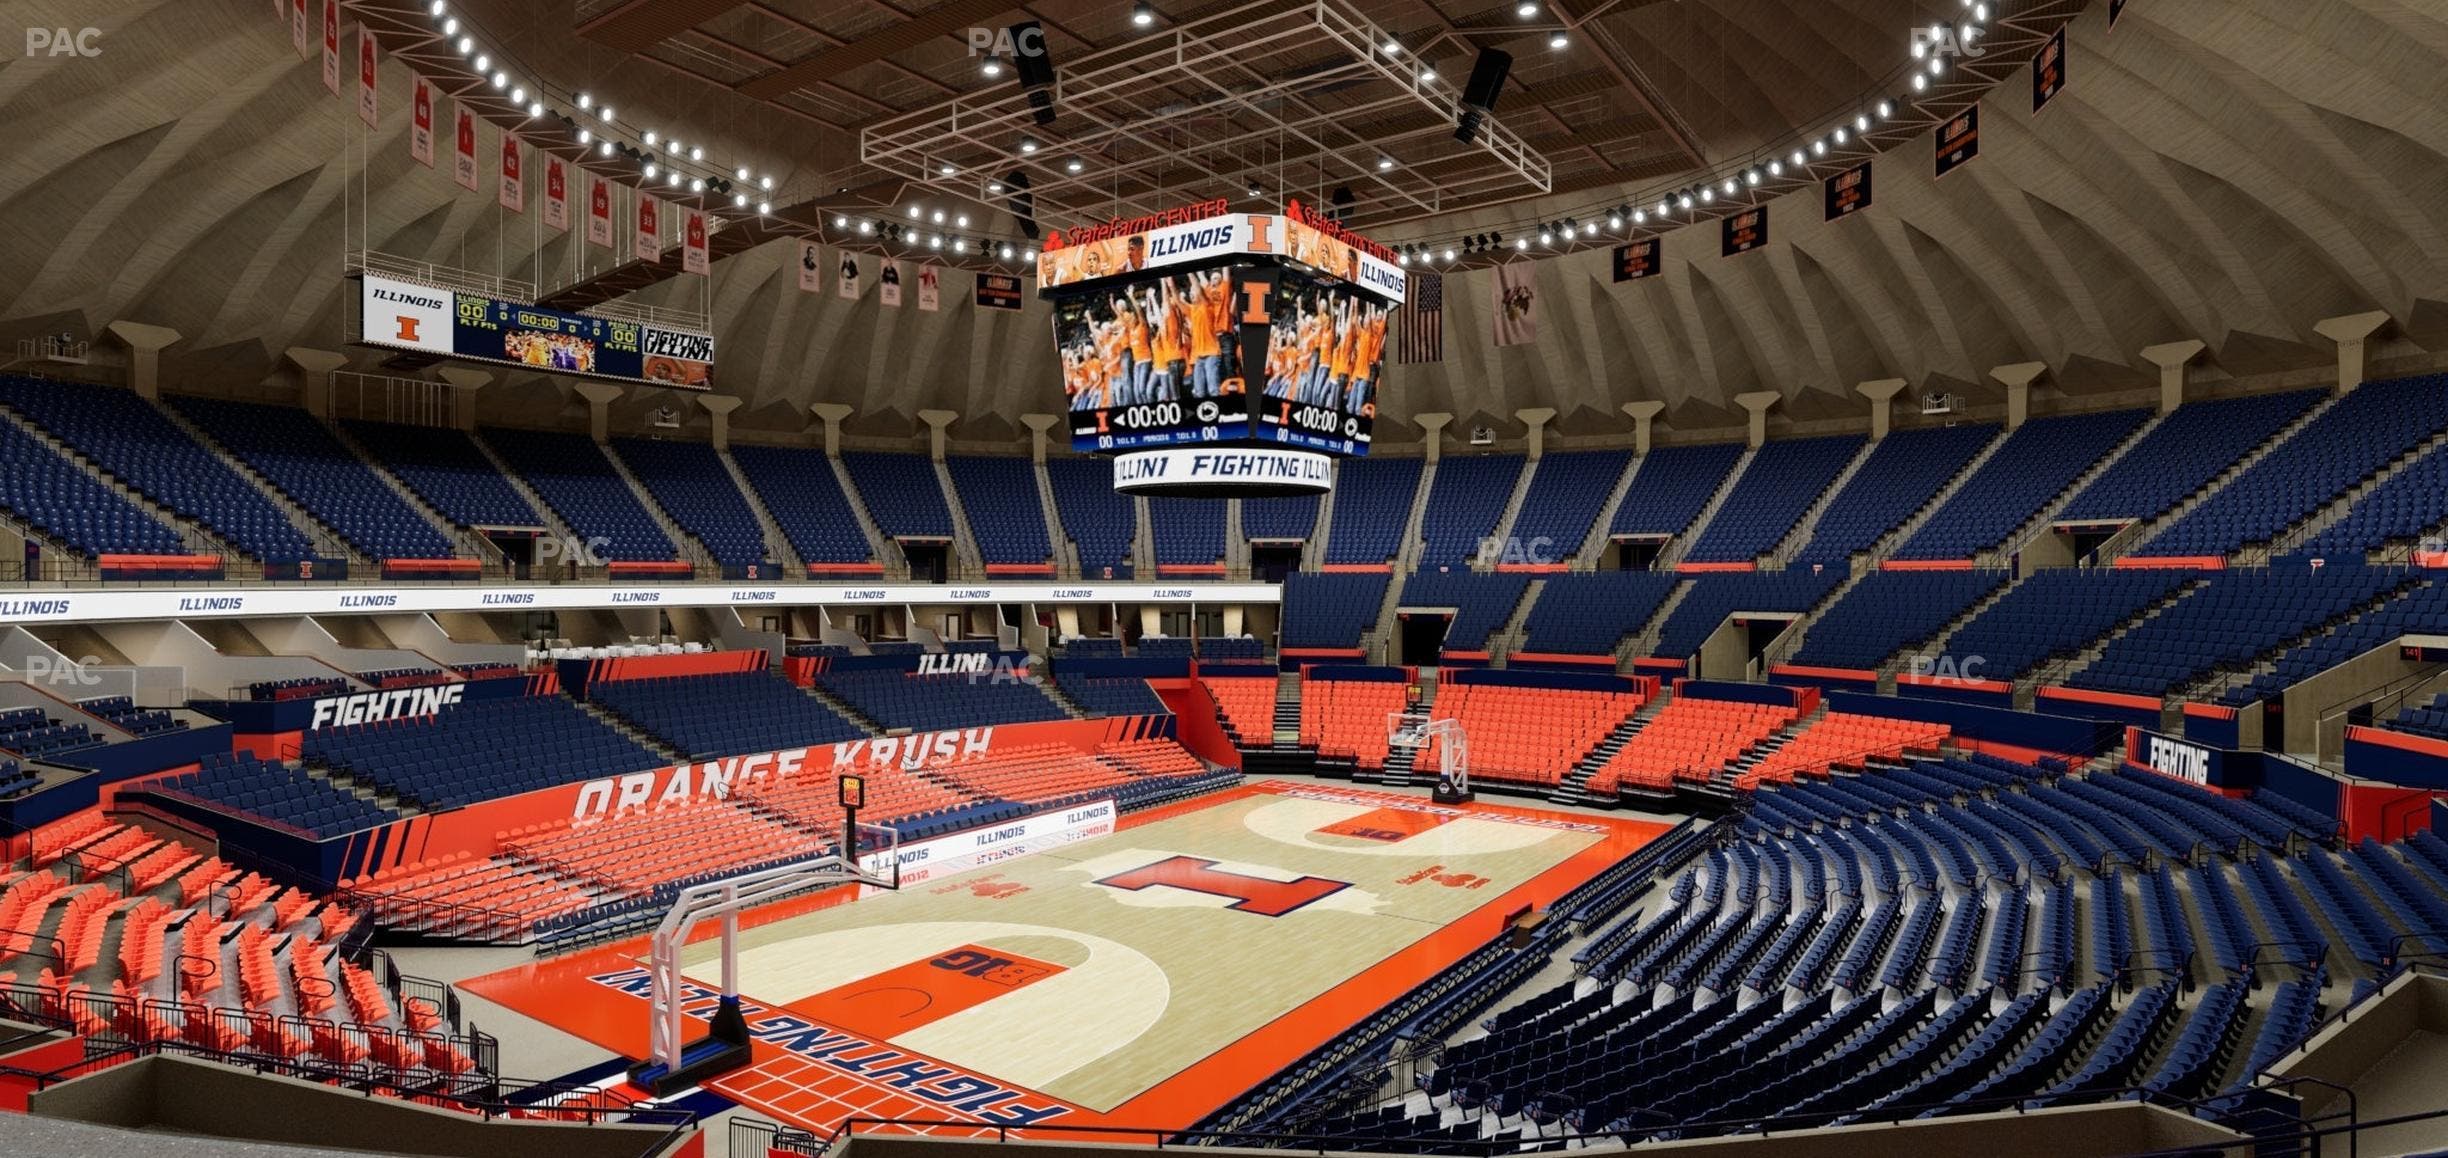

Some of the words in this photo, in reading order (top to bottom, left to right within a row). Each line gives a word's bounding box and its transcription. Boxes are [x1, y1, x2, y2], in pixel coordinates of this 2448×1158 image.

[1151, 224, 1234, 258] ILLINOIS
[1361, 261, 1405, 293] ILLINOIS
[373, 289, 444, 310] ILLINOIS
[459, 304, 484, 319] 00
[520, 314, 558, 329] 00:00
[613, 330, 635, 344] 00
[646, 328, 712, 350] FIGHTING
[645, 338, 713, 362] ILLINI
[1127, 402, 1182, 429] 00:00
[1302, 406, 1338, 433] 00:00
[1098, 435, 1113, 449] 00
[1202, 426, 1219, 441] 00
[1277, 428, 1289, 442] 00
[1343, 440, 1354, 454] 00
[1191, 455, 1299, 478] FIGHTING
[339, 595, 398, 608] ILLINOIS
[481, 593, 536, 605] ILLINOIS
[611, 592, 661, 602] ILLINOIS
[731, 591, 776, 601] ILLINOIS
[843, 590, 886, 600] ILLINOIS
[949, 590, 992, 599] ILLINOIS
[1052, 589, 1094, 599] ILLINOIS
[1153, 589, 1194, 599] ILLINOIS
[0, 600, 70, 616] LLINOIS
[179, 597, 244, 612] ILLINOIS
[917, 652, 988, 675] ILLINI
[311, 684, 465, 732] FIGHTING
[2150, 736, 2210, 786] FIGHTING
[572, 747, 808, 829] ORANGE
[830, 726, 995, 774] KRUSH
[1066, 806, 1110, 824] ILLINOIS
[976, 825, 1026, 847] ILLINOIS
